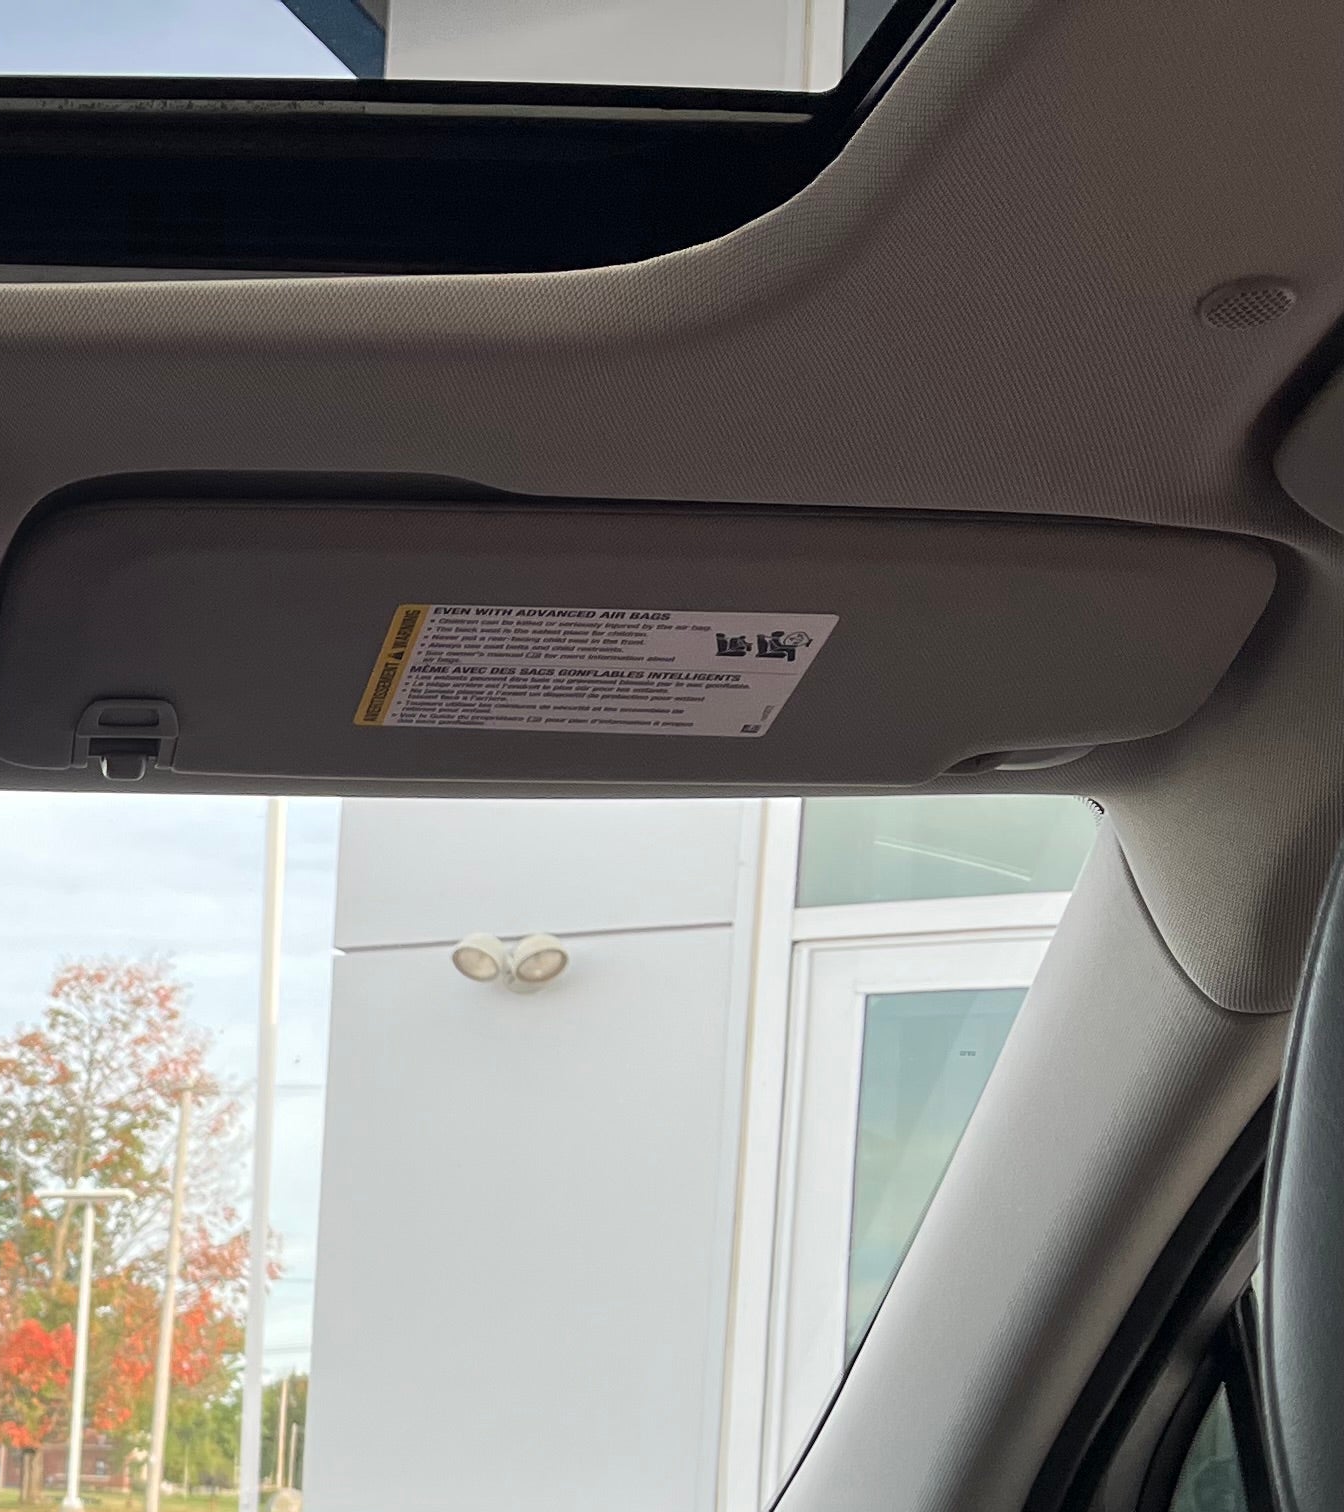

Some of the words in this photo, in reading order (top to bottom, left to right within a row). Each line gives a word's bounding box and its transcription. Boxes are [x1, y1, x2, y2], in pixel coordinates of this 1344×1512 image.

[433, 607, 472, 615] EVEN
[476, 608, 513, 616] WITH
[516, 609, 596, 618] ADVANCED
[599, 611, 626, 619] AIR
[629, 612, 671, 620] BAGS
[451, 666, 488, 674] AVEC
[490, 667, 517, 675] DES
[519, 668, 555, 676] SACS
[558, 669, 644, 679] GONFLABLES
[647, 671, 741, 682] INTELLIGENTS
